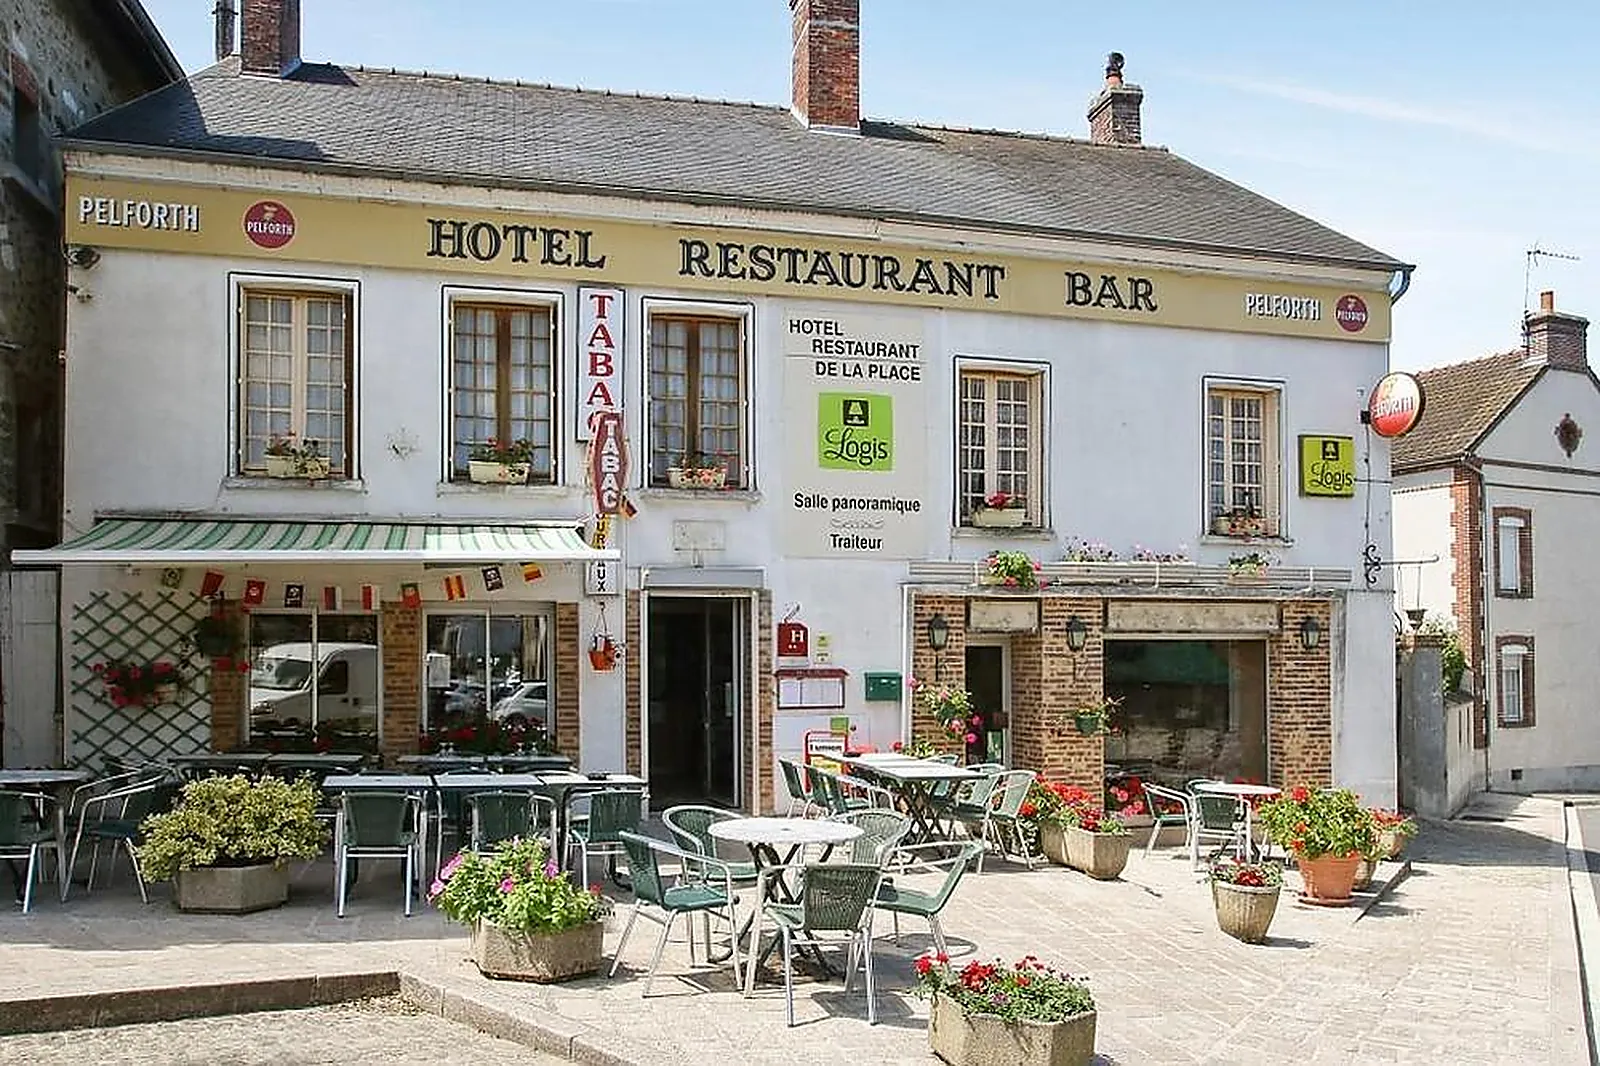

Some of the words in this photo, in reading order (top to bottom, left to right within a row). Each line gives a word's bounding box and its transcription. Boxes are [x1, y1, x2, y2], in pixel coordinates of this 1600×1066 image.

[78, 196, 200, 232] PELFORTH
[247, 220, 294, 236] PELFORTH
[427, 218, 606, 269] HOTEL
[679, 237, 1005, 299] RESTAURANT
[1064, 271, 1158, 312] BAR
[1246, 293, 1321, 321] PELFORTH
[789, 319, 844, 336] HOTEL
[812, 338, 920, 359] RESTAURANT
[815, 361, 838, 376] DE
[842, 363, 863, 378] LA
[868, 364, 921, 381] PLACE
[823, 427, 888, 466] Logis
[601, 420, 620, 508] TABAC
[1310, 461, 1353, 491] Logis
[793, 492, 829, 510] Salle
[831, 496, 922, 515] panoramique
[829, 533, 884, 550] Traiteur
[791, 630, 804, 643] H
